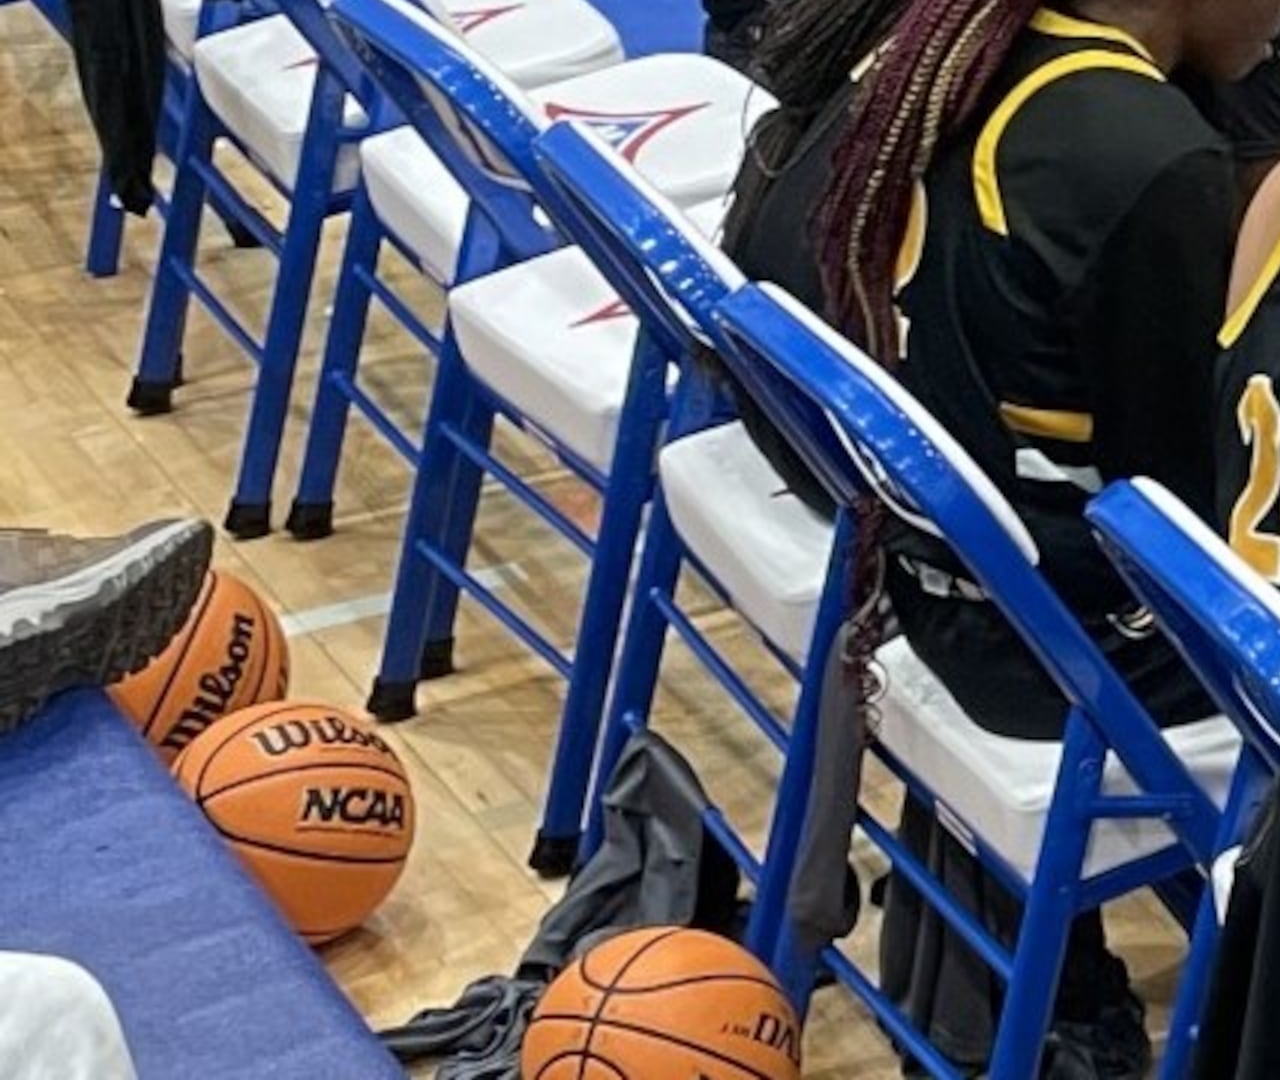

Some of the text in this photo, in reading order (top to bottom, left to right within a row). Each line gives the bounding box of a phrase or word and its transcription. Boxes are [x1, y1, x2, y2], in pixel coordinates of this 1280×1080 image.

[160, 612, 253, 749] Wilson
[253, 716, 400, 762] Wilso
[302, 788, 404, 830] NCAA
